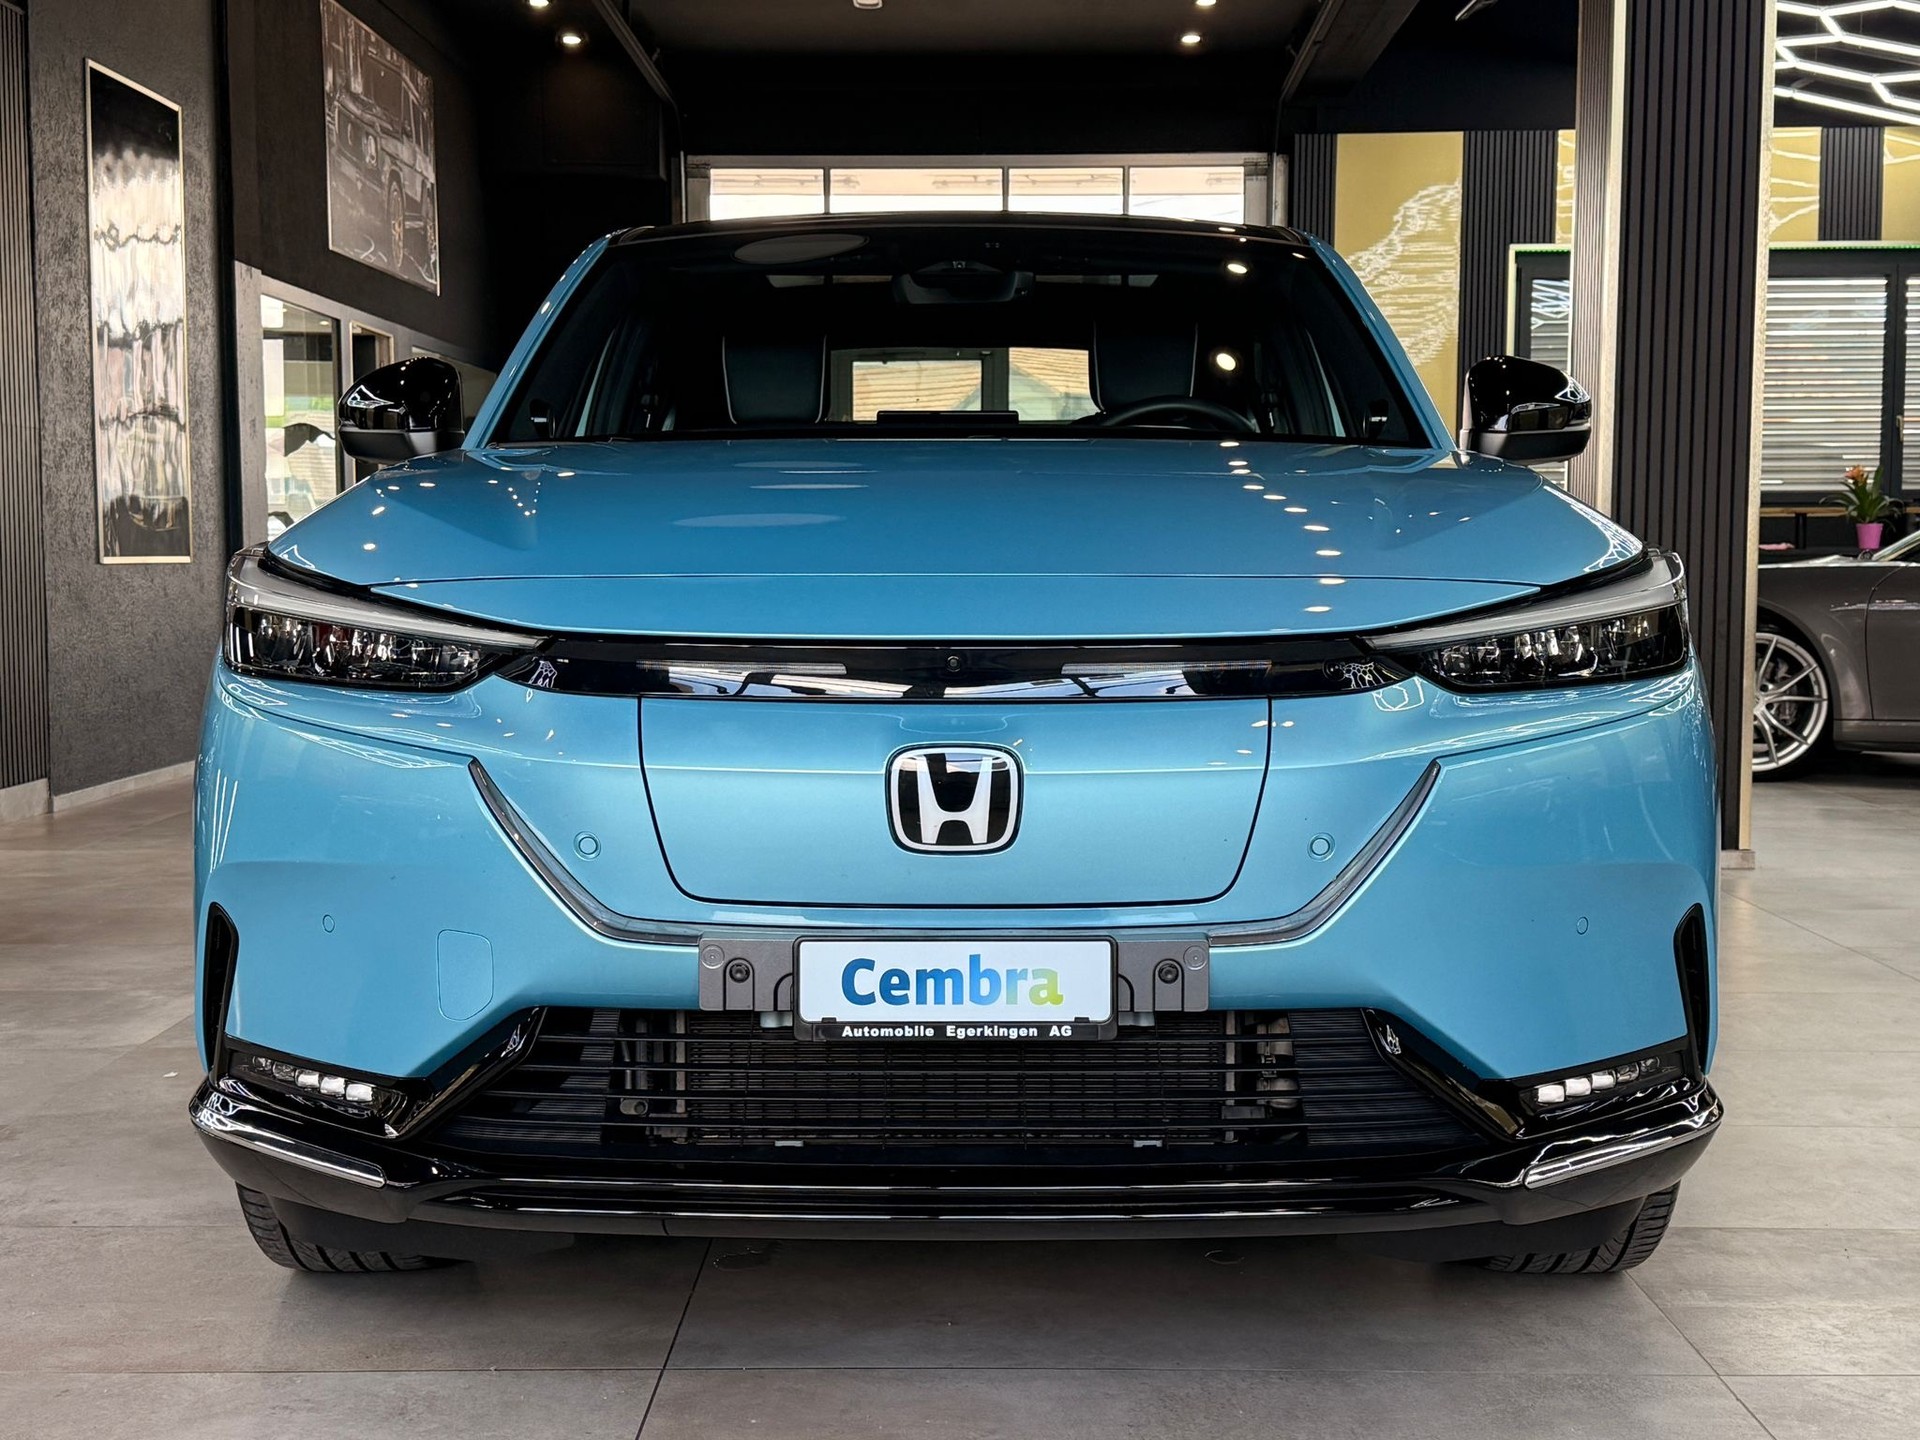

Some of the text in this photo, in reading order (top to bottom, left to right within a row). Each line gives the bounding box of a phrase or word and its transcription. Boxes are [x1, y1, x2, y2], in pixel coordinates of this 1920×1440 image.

[841, 954, 1064, 1006] Cembra
[842, 1025, 1072, 1040] Automobile Egerkingen AG
